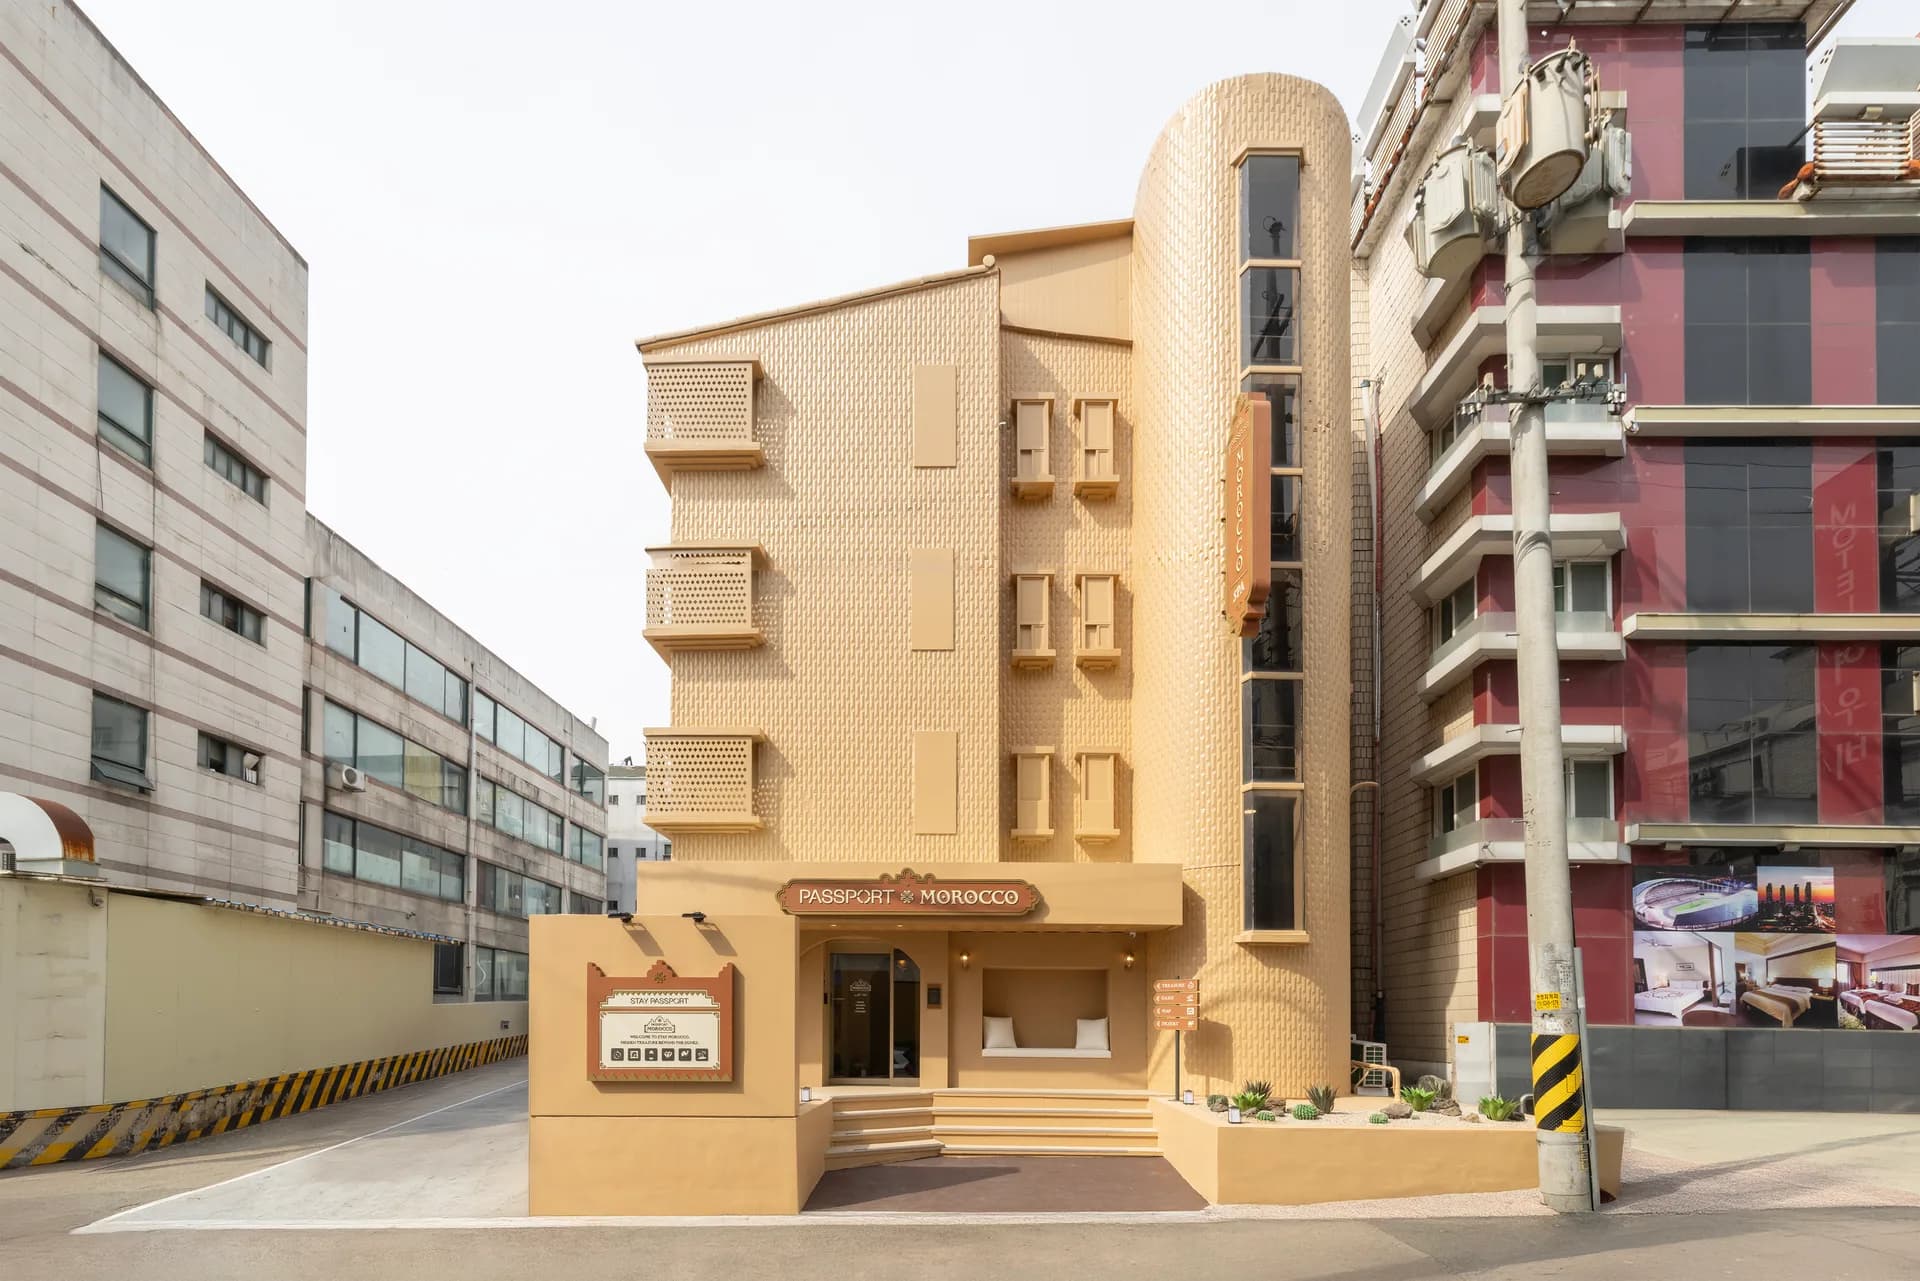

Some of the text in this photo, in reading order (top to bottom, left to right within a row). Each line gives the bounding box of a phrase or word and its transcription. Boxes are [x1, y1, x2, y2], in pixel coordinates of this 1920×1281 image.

[1235, 447, 1245, 574] MOROCCO
[799, 888, 1019, 905] PASSPORT MOROCCO
[630, 997, 689, 1005] STAY PASSPORT
